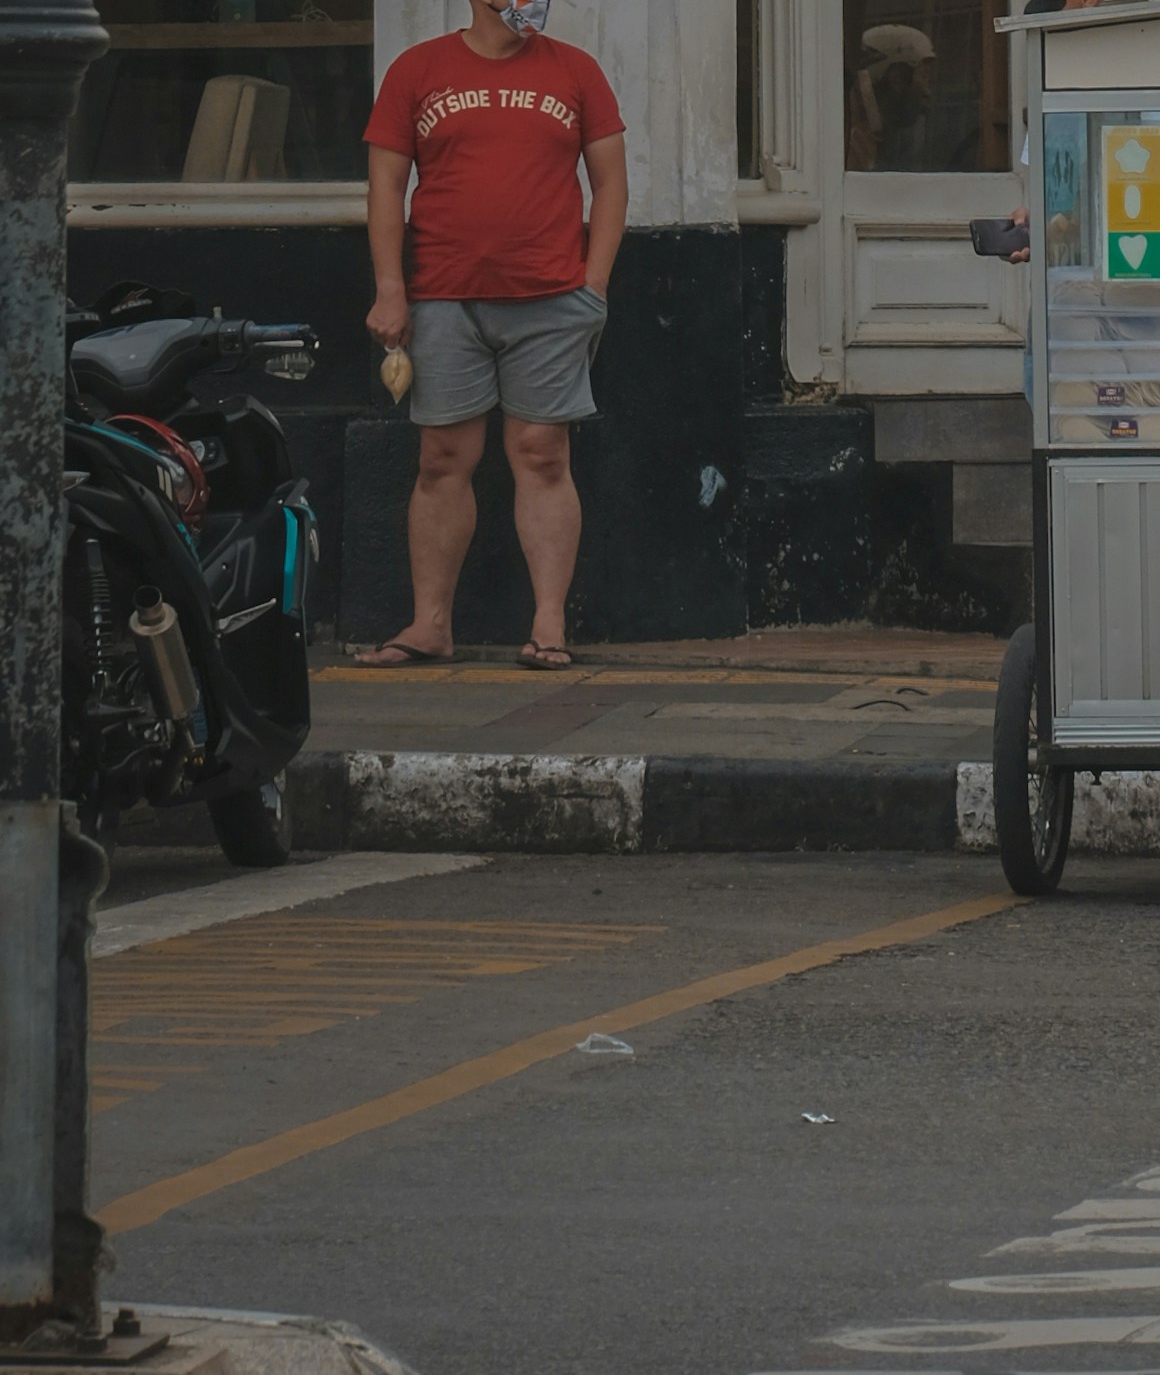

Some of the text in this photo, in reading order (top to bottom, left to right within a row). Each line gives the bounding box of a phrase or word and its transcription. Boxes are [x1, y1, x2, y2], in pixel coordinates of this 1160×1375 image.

[416, 89, 577, 139] OUTSIDE THE BOX
